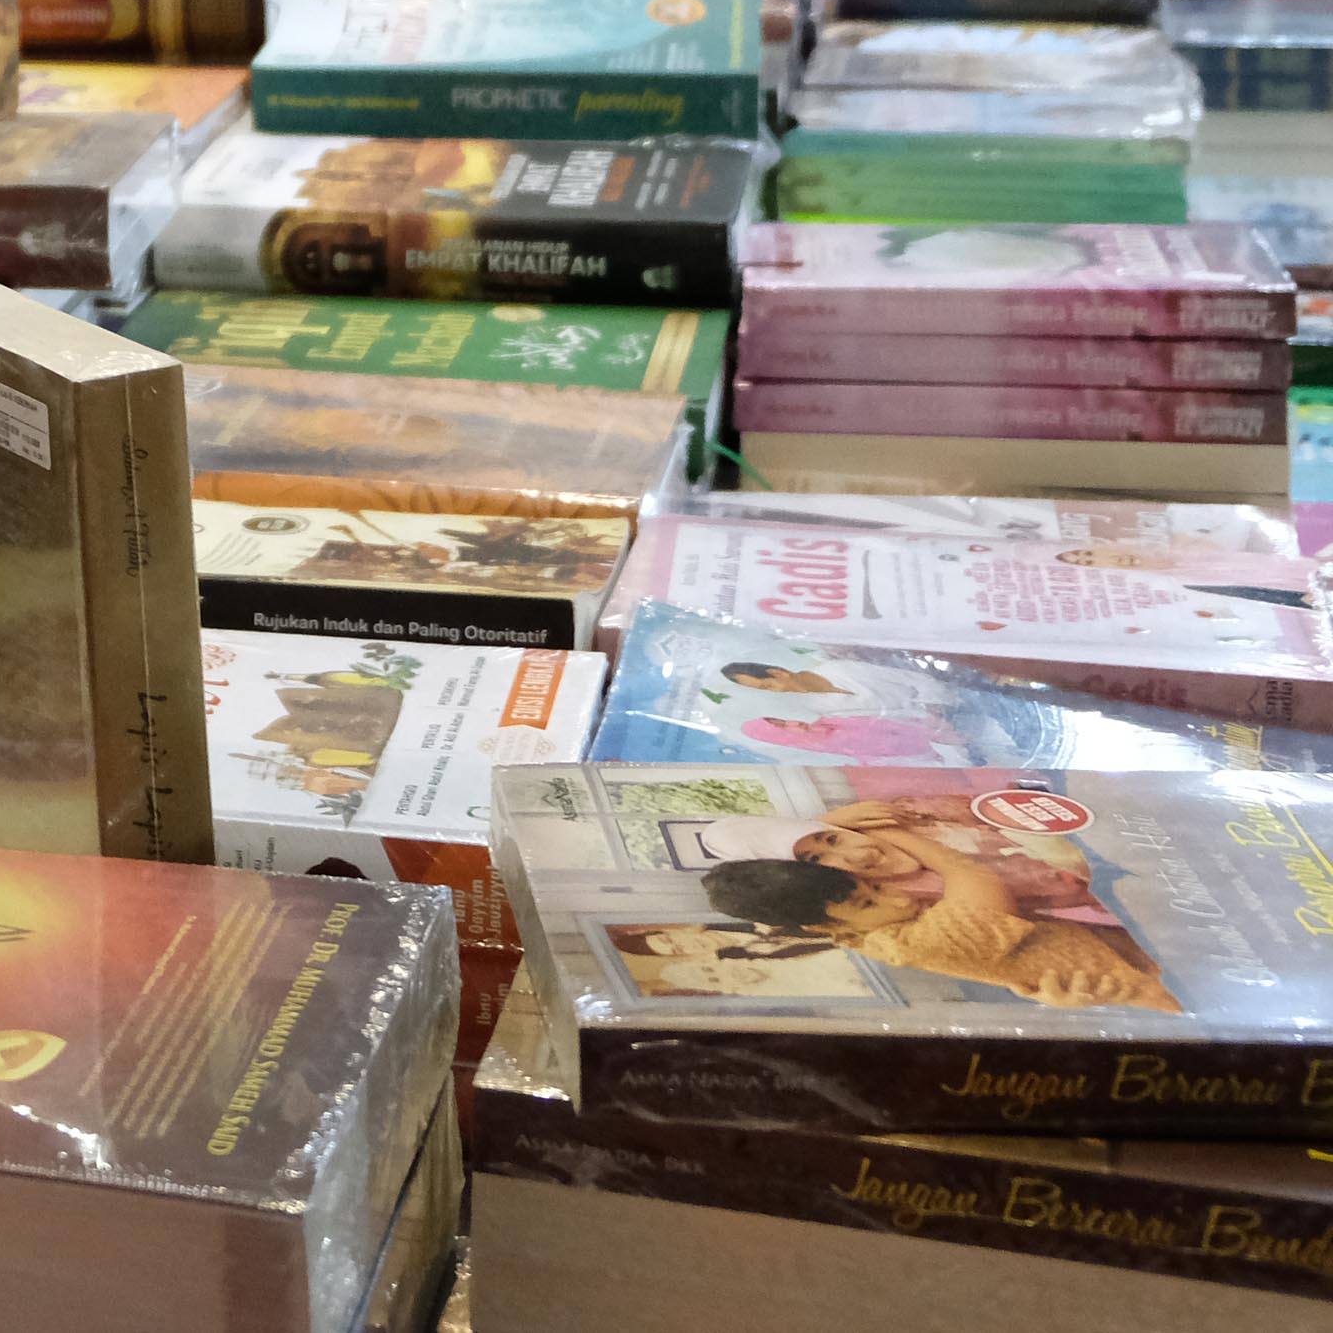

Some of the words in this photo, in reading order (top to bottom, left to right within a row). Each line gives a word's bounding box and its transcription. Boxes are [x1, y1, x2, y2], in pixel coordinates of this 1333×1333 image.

[451, 86, 567, 112] PROPHETIC
[486, 250, 608, 276] KHALIFAH
[753, 534, 850, 623] Gadis
[252, 611, 320, 633] Rujukan
[323, 615, 369, 634] Induk
[372, 618, 404, 636] dan
[407, 619, 461, 642] Paling
[464, 623, 549, 646] Otoritatif
[509, 695, 542, 723] EDISI
[320, 902, 360, 940] PROF.
[259, 966, 326, 1058] MUHAMMAD
[228, 1057, 279, 1113] SAMEH
[941, 1052, 1089, 1121] Jangan
[1109, 1053, 1281, 1107] Bercerai
[205, 1115, 249, 1157] SAID
[831, 1157, 980, 1228] Jangan
[1002, 1175, 1181, 1243] Bercerai
